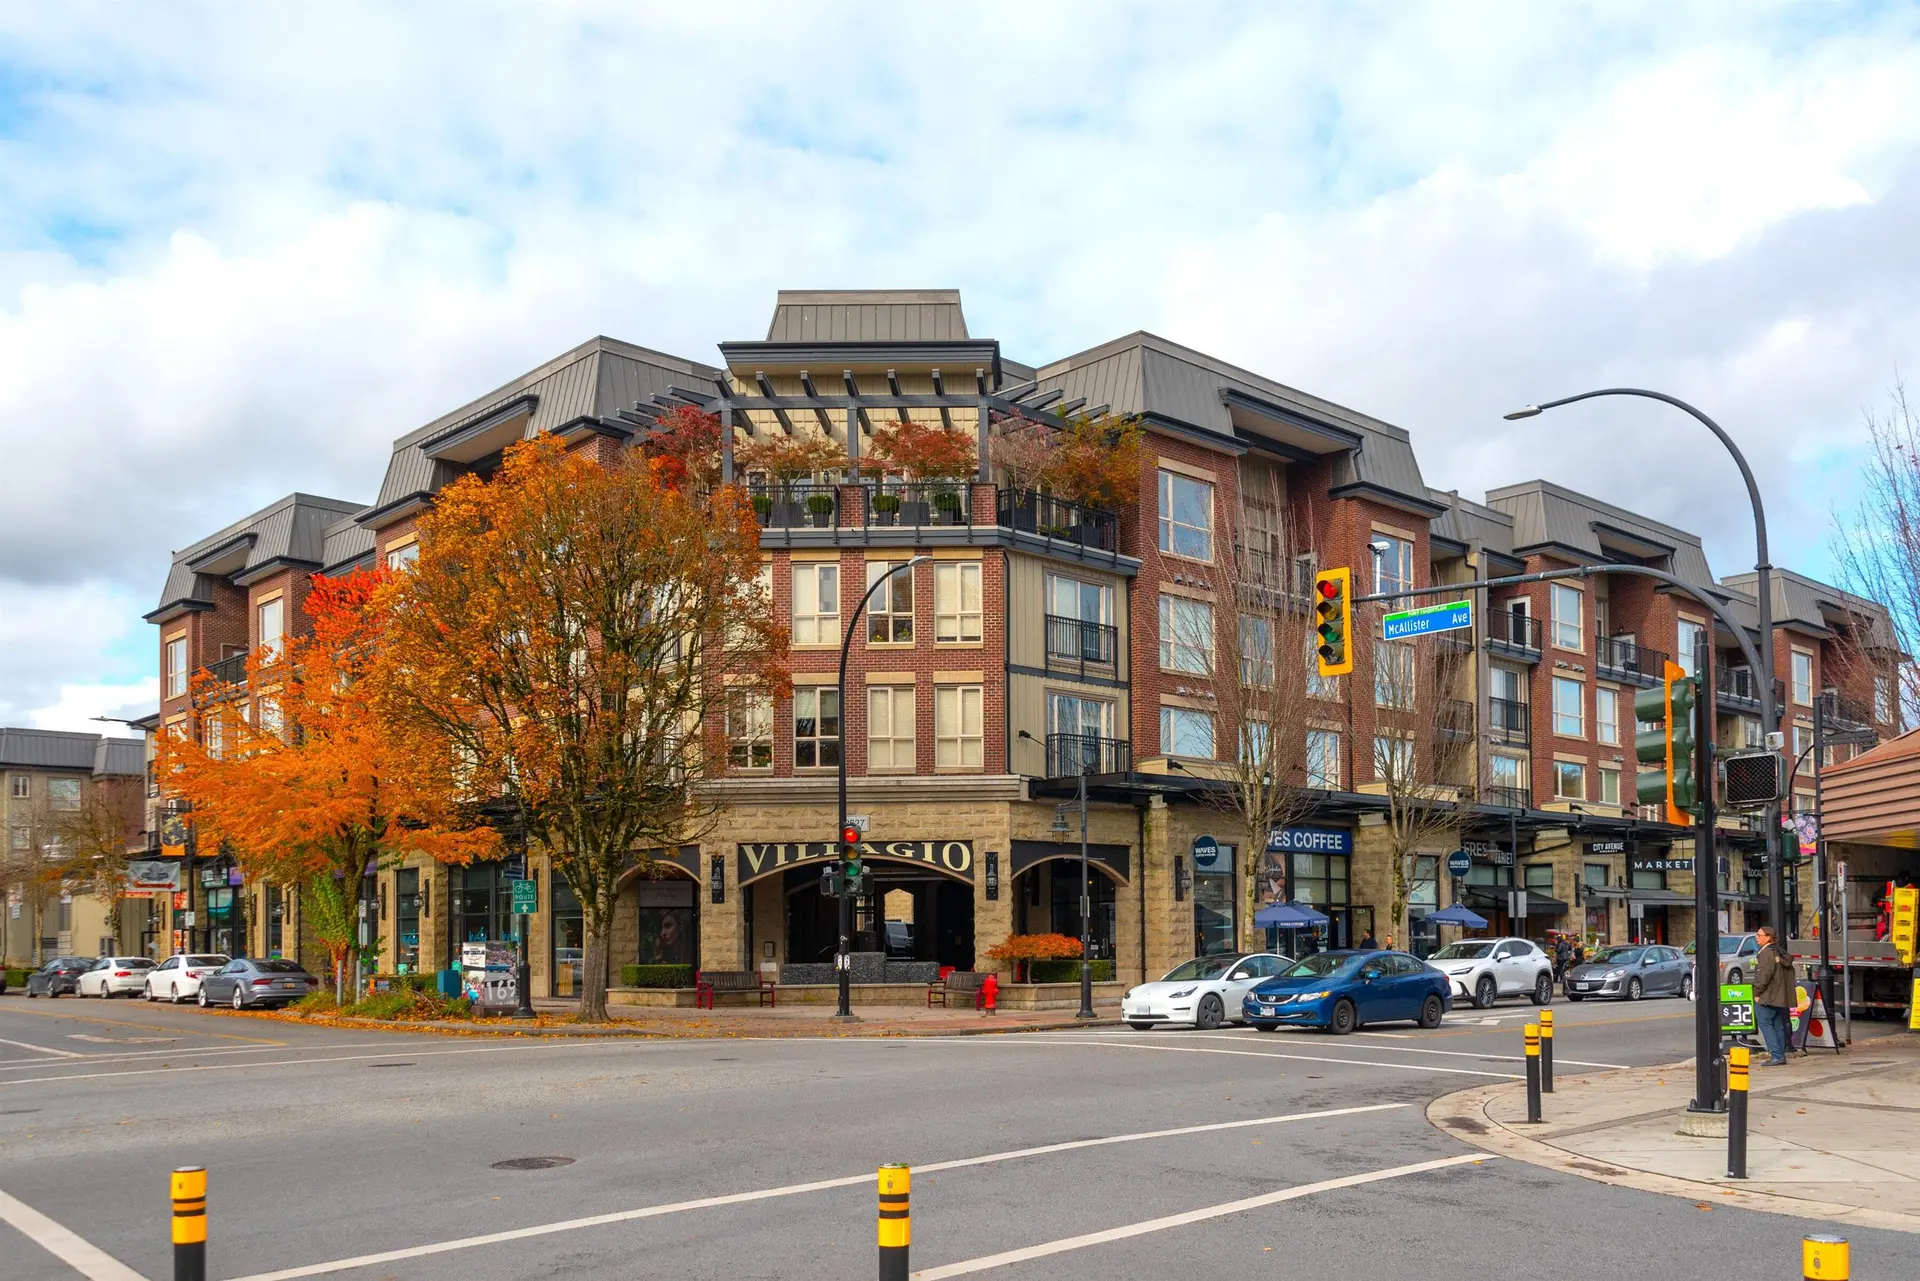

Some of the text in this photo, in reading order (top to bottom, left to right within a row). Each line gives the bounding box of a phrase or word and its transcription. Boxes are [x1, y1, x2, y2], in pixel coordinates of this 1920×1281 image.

[1388, 613, 1467, 634] McAllister Ave
[1293, 832, 1343, 850] COFFEE
[1593, 842, 1624, 852] CITY AVENUE
[1634, 860, 1689, 869] MARKET
